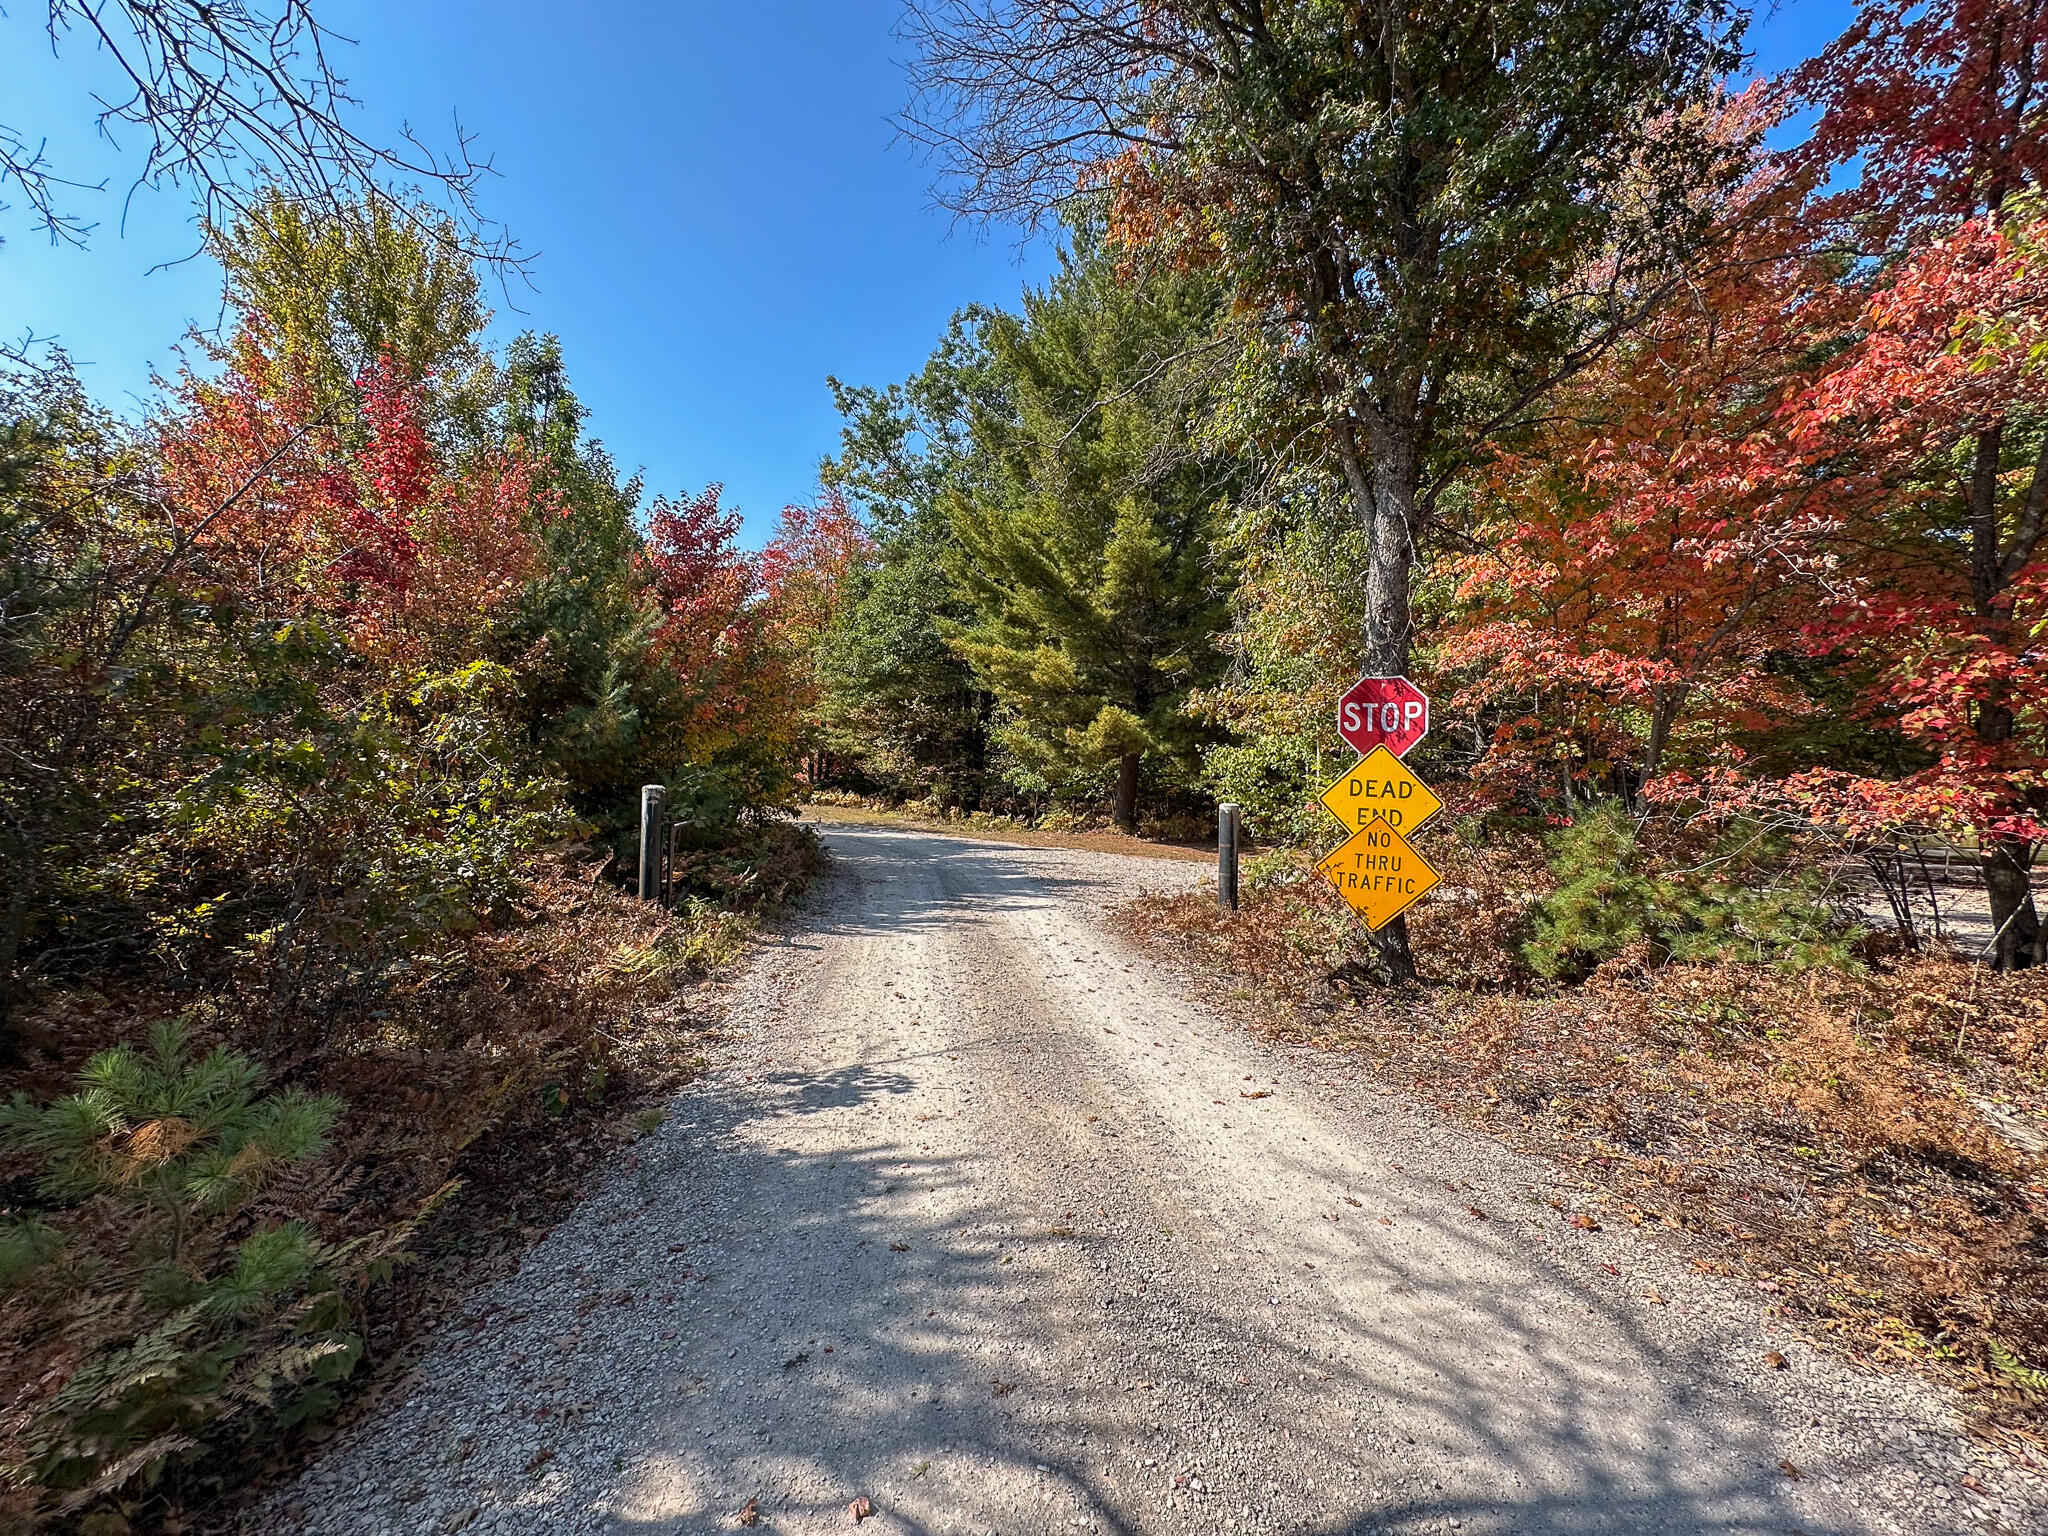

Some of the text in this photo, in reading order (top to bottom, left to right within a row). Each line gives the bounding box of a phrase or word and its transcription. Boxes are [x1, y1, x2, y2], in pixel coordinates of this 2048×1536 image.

[1343, 701, 1423, 732] STOP
[1350, 779, 1413, 799] DEAD
[1367, 831, 1391, 848] NO
[1355, 853, 1402, 871] THRU
[1336, 871, 1416, 894] TRAFFIC
